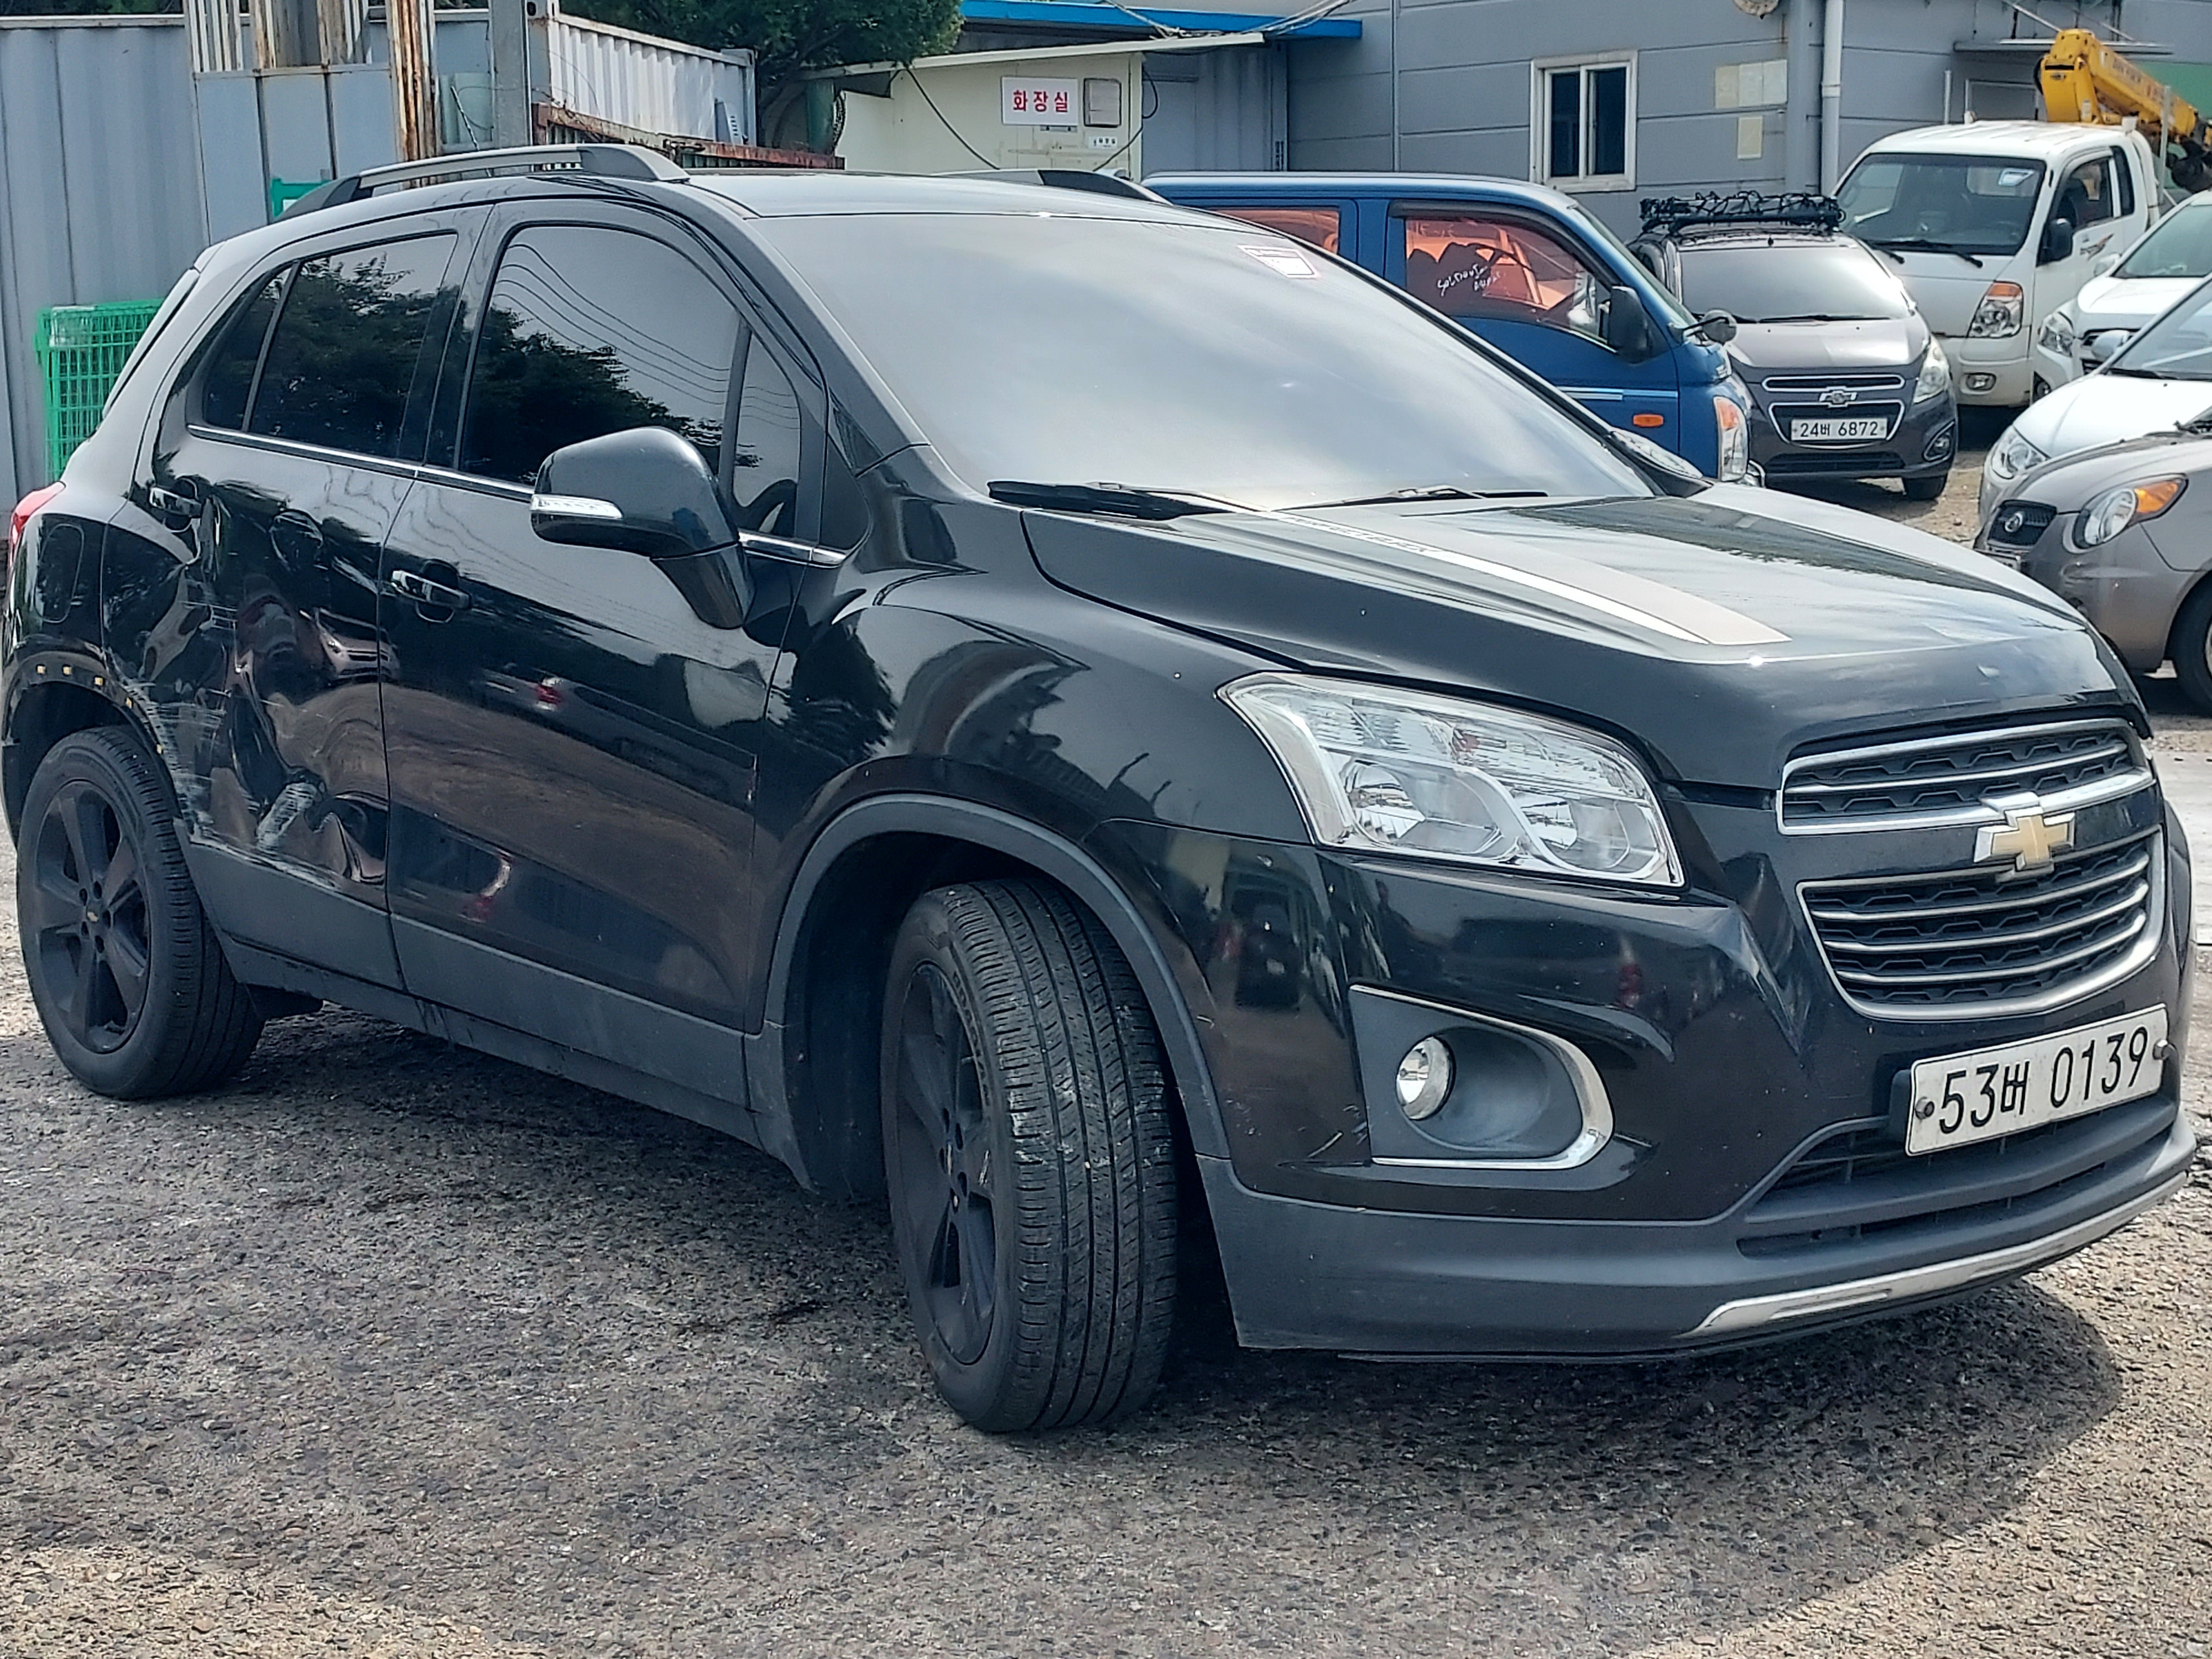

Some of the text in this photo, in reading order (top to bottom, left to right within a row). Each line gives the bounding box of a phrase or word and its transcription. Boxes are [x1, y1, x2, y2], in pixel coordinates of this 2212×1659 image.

[1013, 90, 1068, 112] 화장실
[1800, 421, 1878, 437] 24버 6872
[1939, 1026, 2148, 1134] 53버 0139
